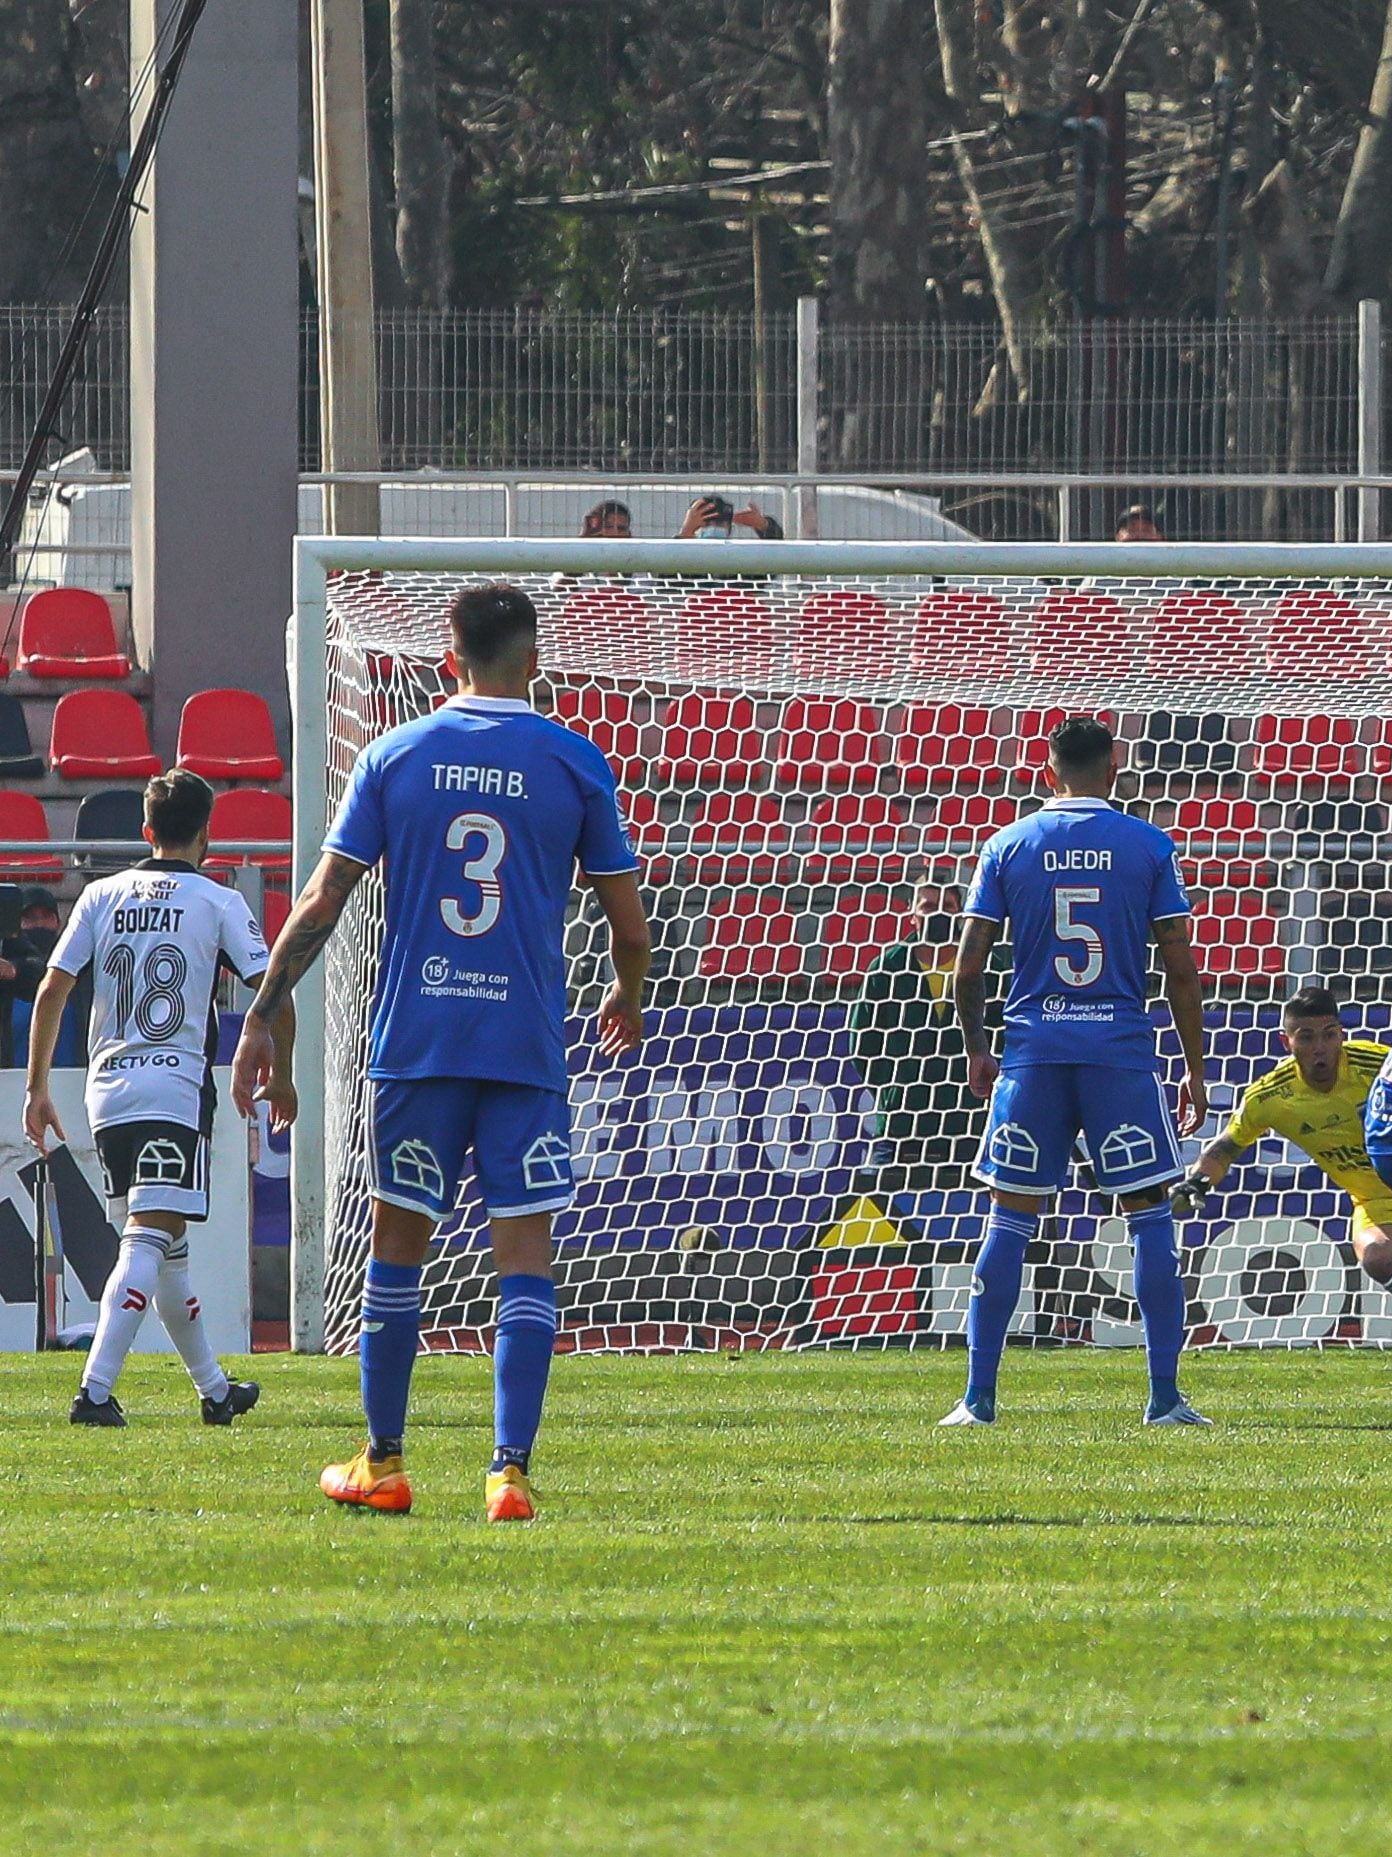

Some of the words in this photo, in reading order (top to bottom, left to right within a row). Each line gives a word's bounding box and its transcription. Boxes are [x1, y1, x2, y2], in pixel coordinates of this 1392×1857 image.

[431, 763, 502, 796] TAPIA
[506, 771, 529, 800] B.
[1044, 850, 1112, 871] OJEDA
[440, 811, 507, 938] 3
[114, 906, 184, 934] BOUZAT
[1054, 886, 1104, 988] 5
[453, 969, 487, 985] Juega
[489, 973, 509, 985] con
[103, 942, 188, 1042] 18
[420, 985, 507, 1002] responsabilidad
[1041, 1012, 1114, 1023] responsabilidad
[152, 1055, 180, 1067] GO
